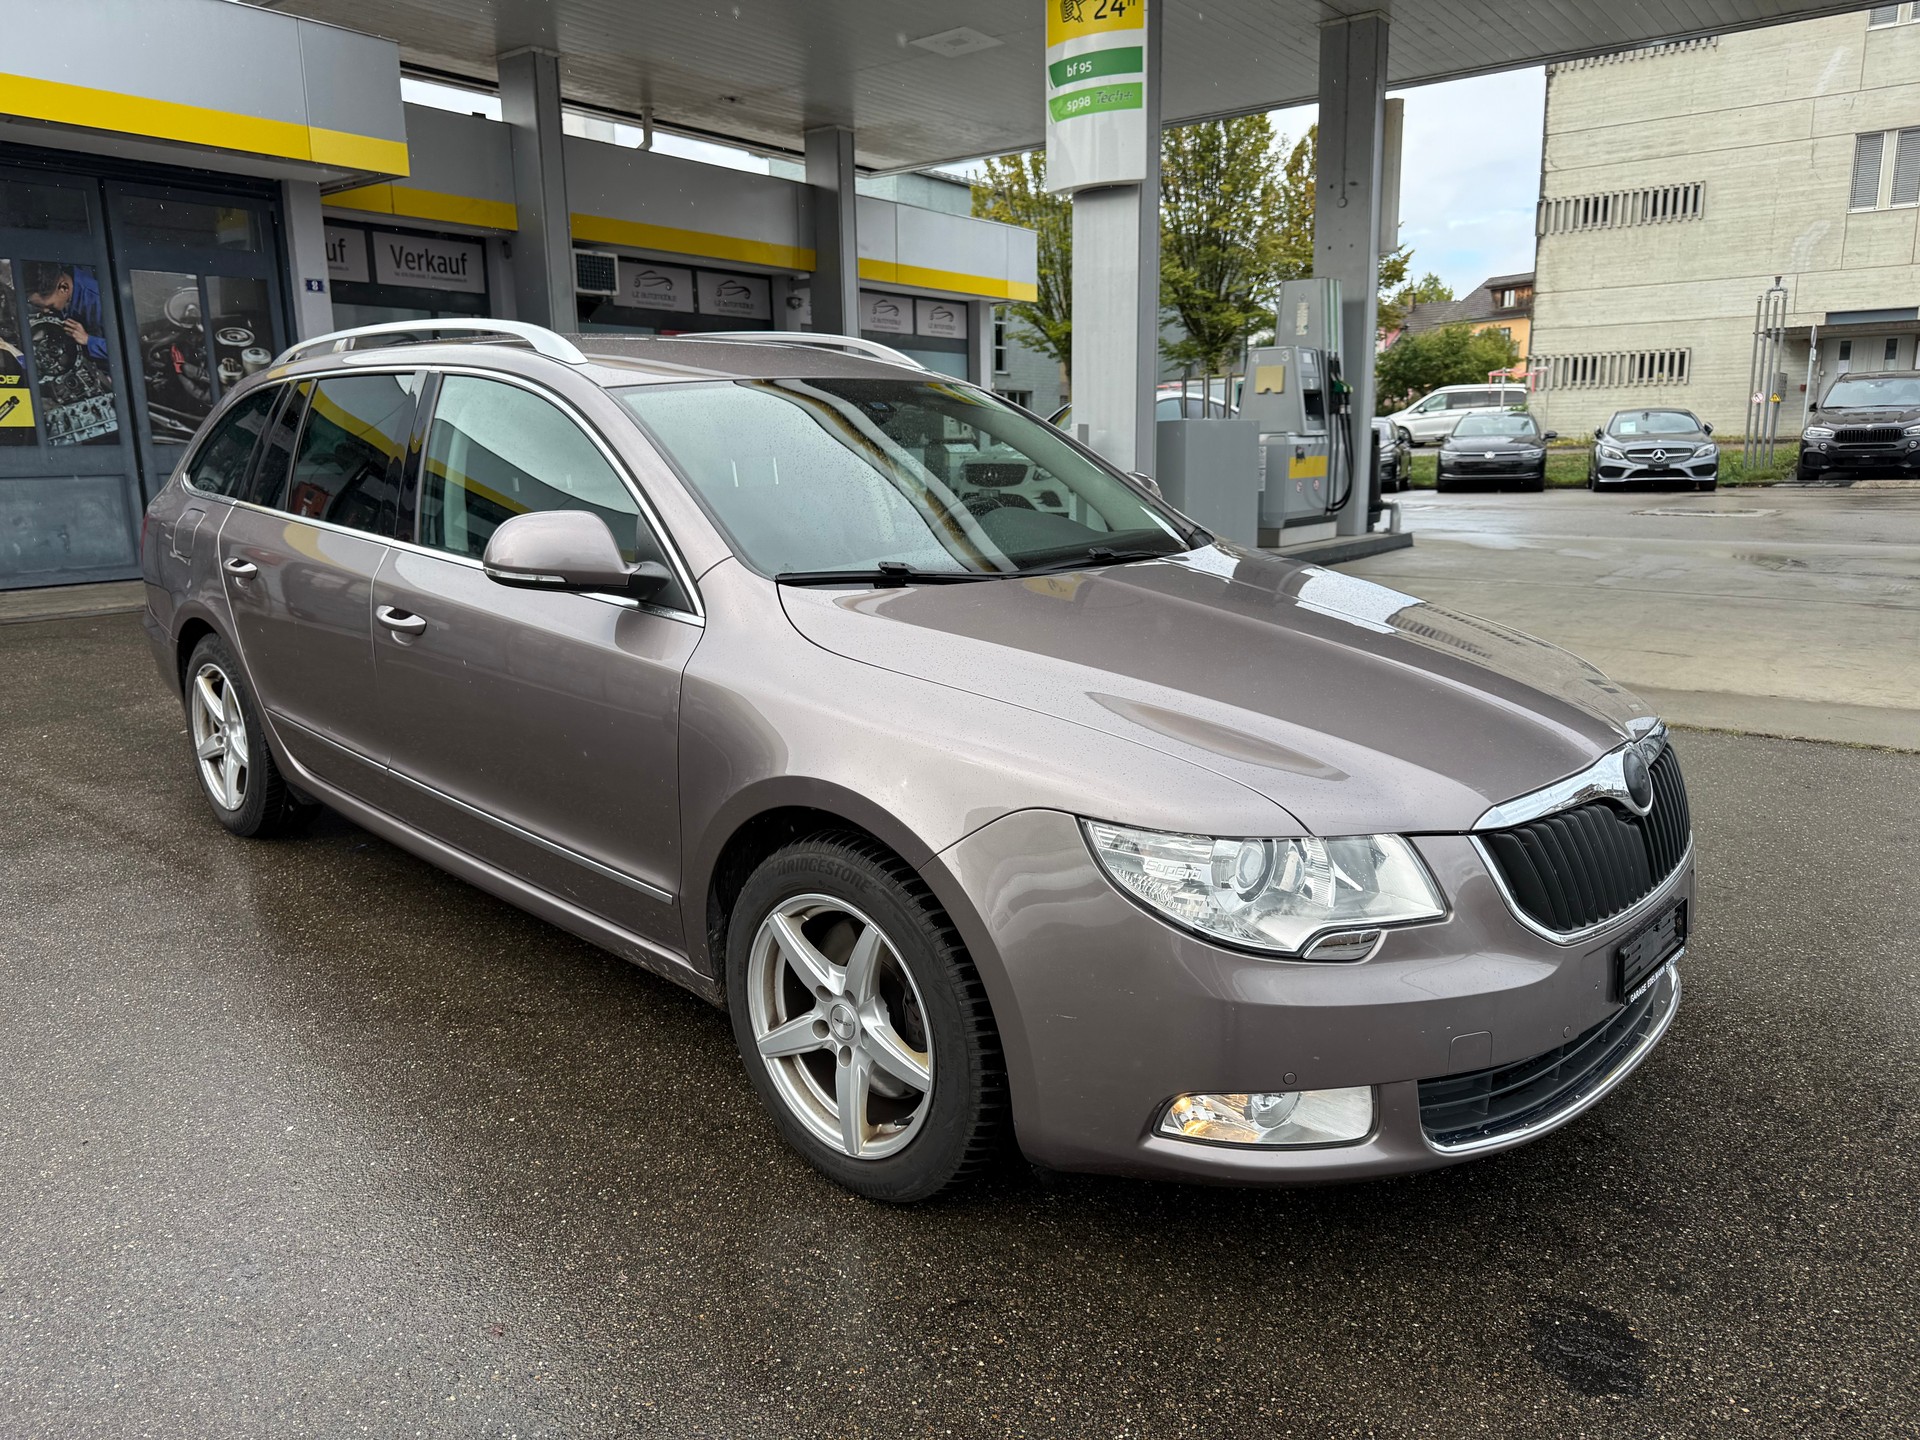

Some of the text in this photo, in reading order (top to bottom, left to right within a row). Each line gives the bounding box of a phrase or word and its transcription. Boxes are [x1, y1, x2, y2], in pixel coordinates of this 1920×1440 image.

[1066, 60, 1092, 77] bf 95
[1066, 96, 1091, 112] sp98
[390, 243, 468, 276] Verkauf
[1281, 350, 1290, 361] 3
[778, 856, 873, 894] BRIDGESTONE
